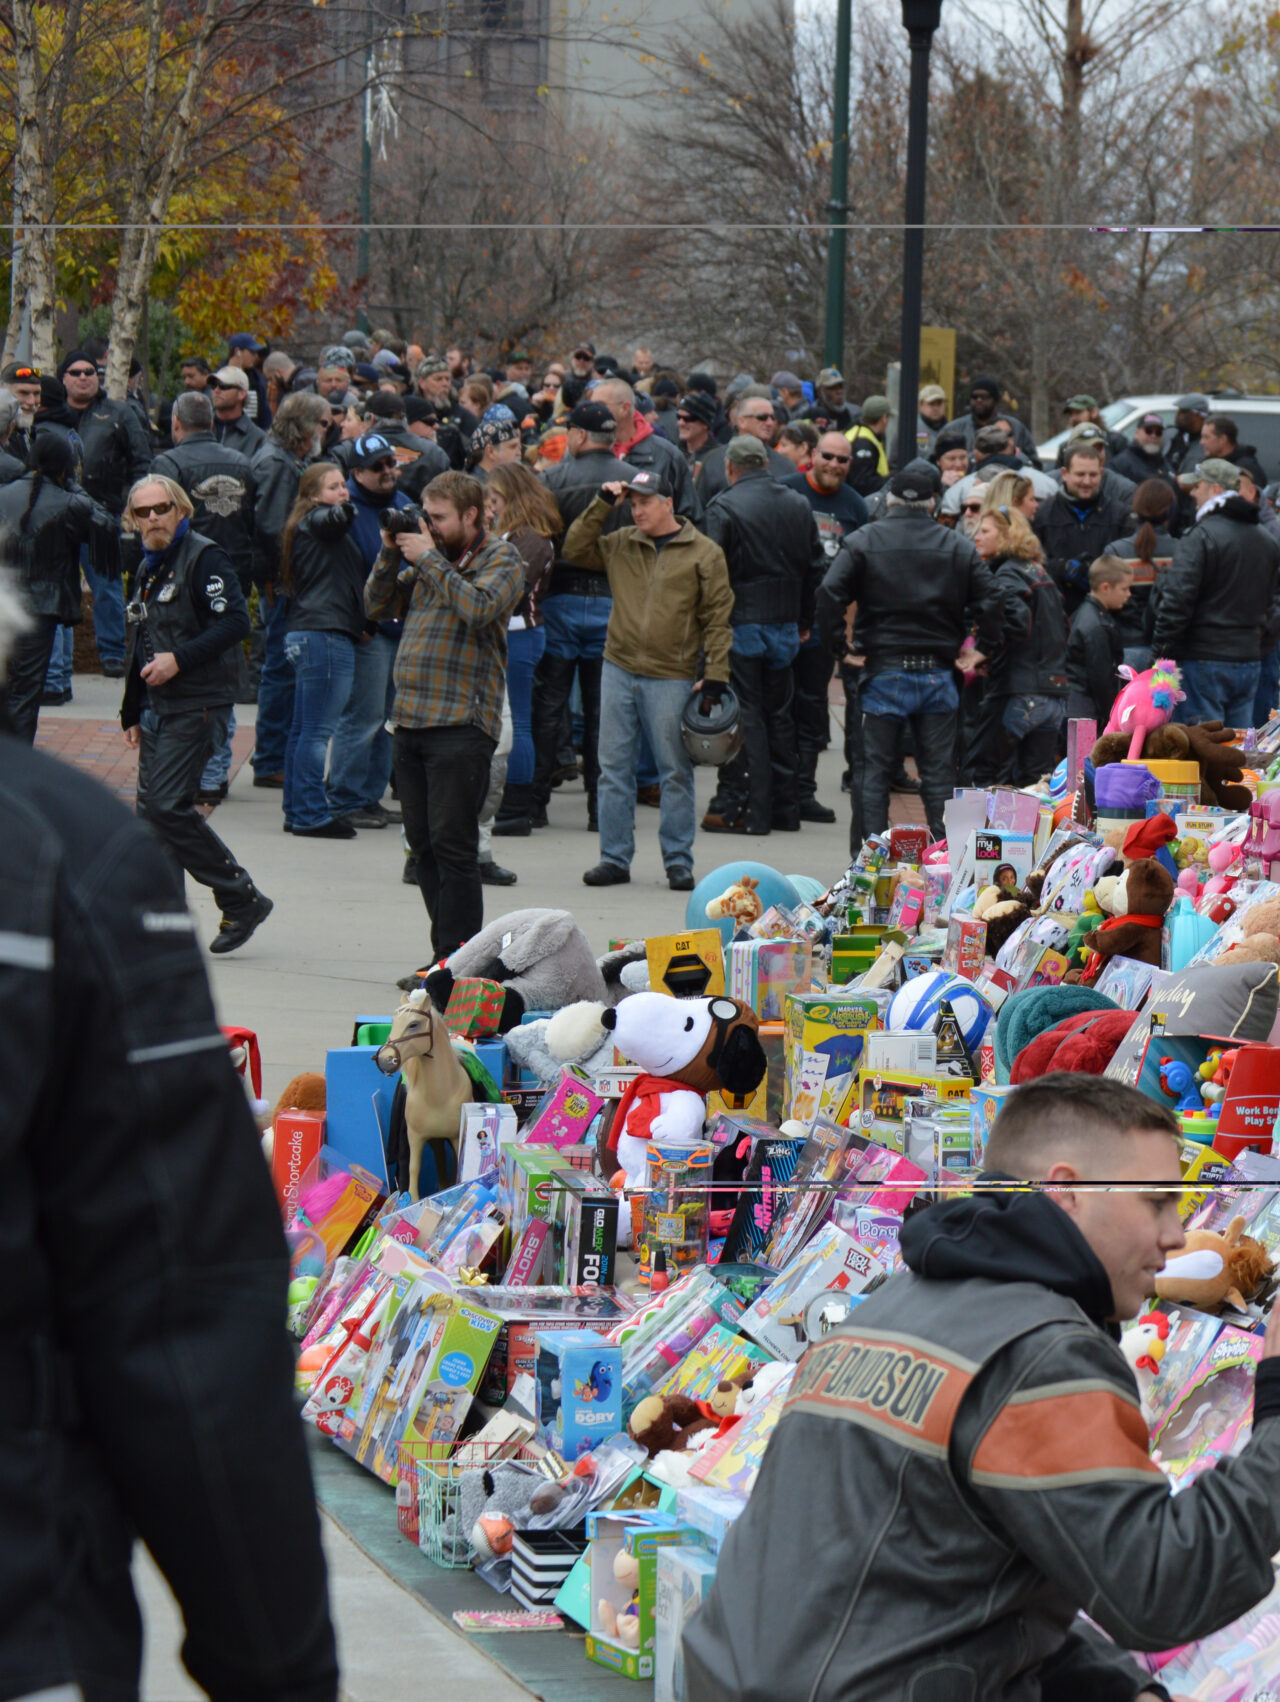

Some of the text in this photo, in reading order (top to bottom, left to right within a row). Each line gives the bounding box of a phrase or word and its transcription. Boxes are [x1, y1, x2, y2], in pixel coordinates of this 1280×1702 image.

[977, 839, 993, 851] my
[675, 940, 691, 951] CAT
[837, 1005, 864, 1013] MARKER
[1236, 1106, 1256, 1116] Work
[1244, 1116, 1265, 1127] Play
[284, 1131, 303, 1202] Shortcake
[596, 1208, 605, 1252] GLOMAX
[858, 1219, 899, 1238] Pony
[848, 1251, 869, 1266] TECH
[847, 1259, 867, 1275] DECK
[469, 1318, 492, 1333] KIDS
[575, 1411, 616, 1424] DORY
